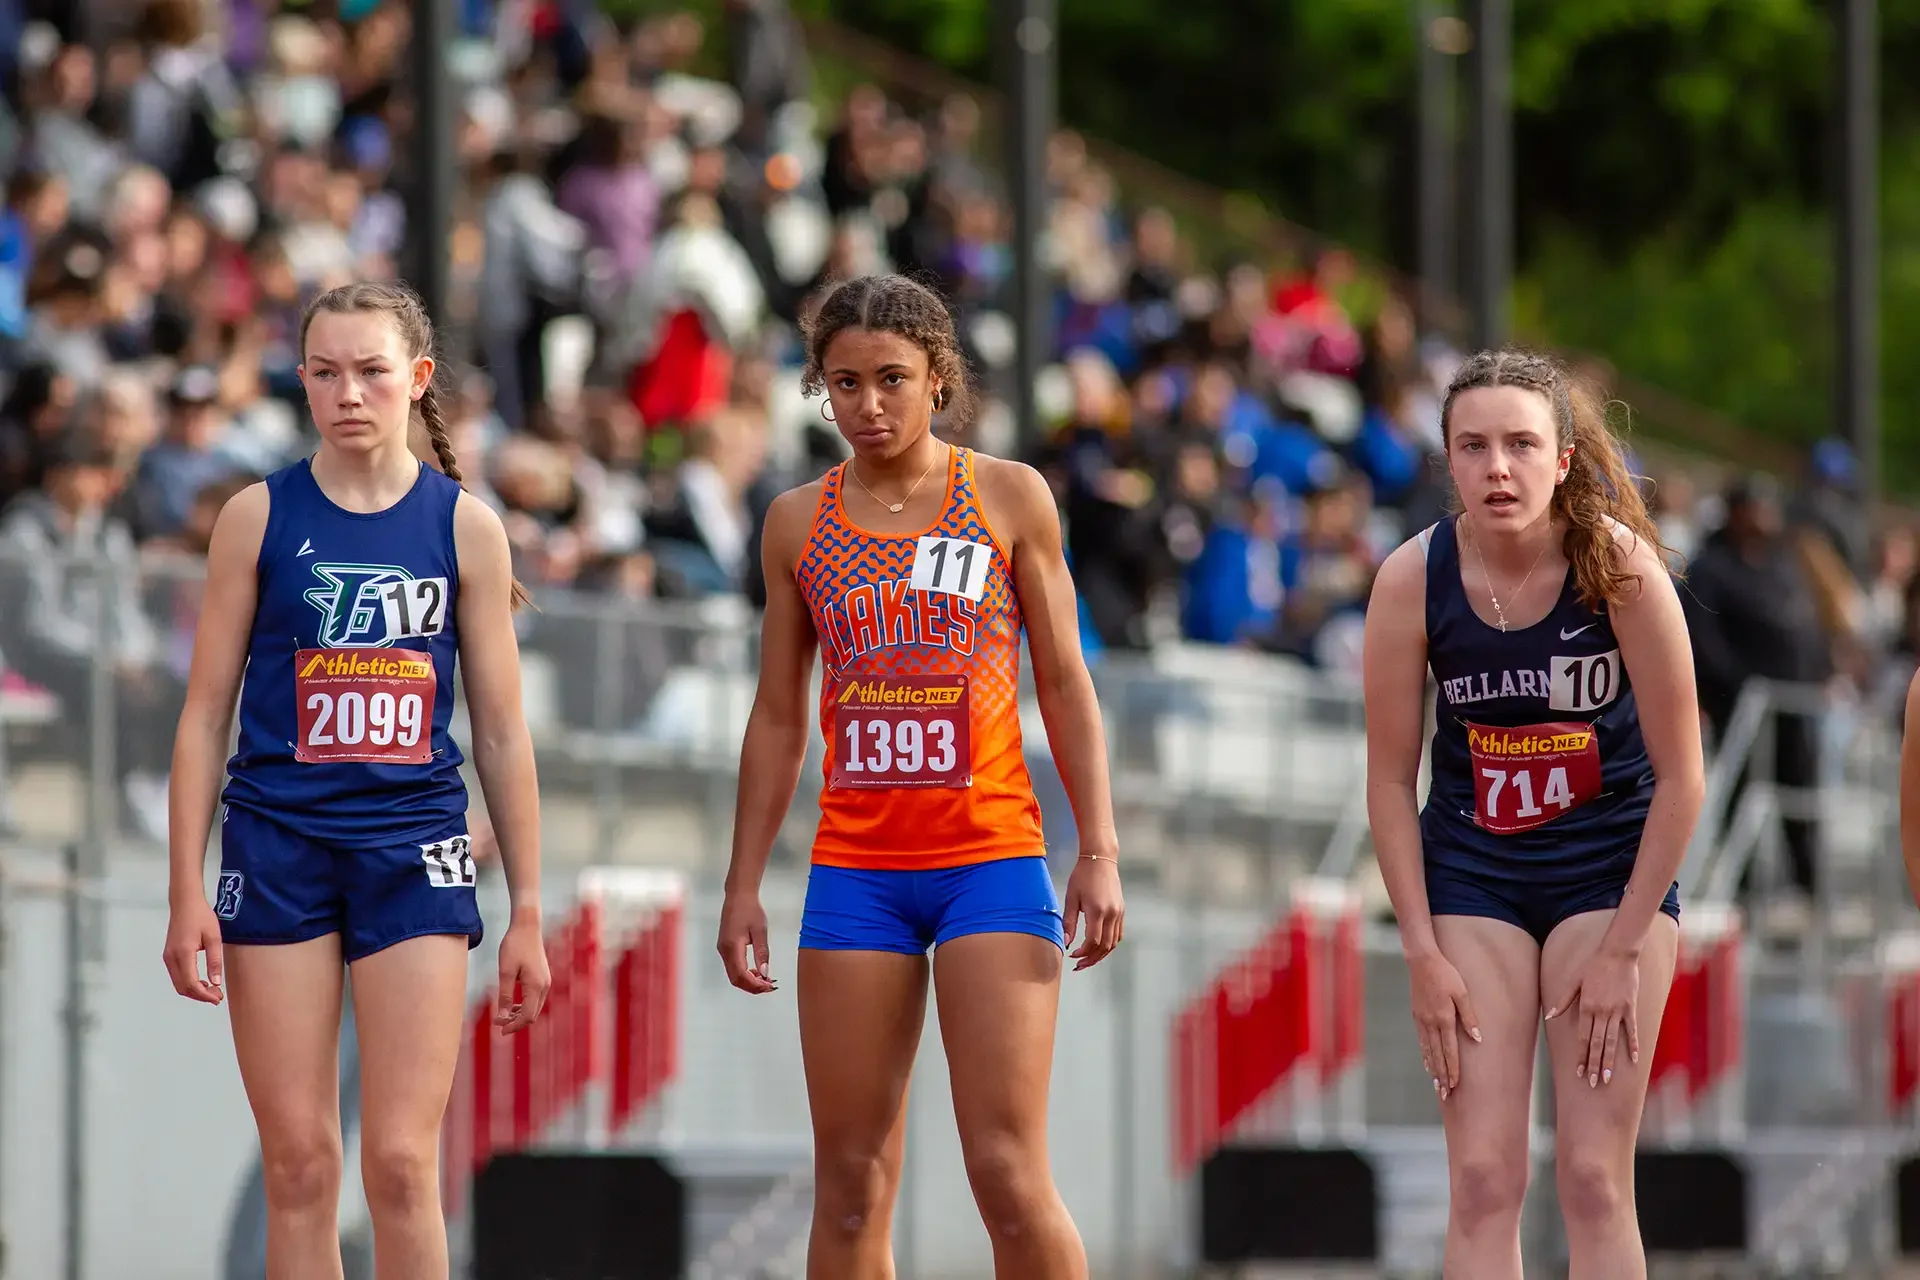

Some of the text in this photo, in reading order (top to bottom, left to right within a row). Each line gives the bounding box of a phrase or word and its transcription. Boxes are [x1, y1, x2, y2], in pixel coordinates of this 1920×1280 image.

[929, 540, 975, 593] 11
[387, 580, 441, 635] 12
[824, 578, 977, 670] LAKES
[1563, 656, 1611, 708] 10
[306, 691, 423, 747] 2099
[845, 719, 957, 773] 1393
[1482, 766, 1575, 818] 714
[426, 838, 473, 884] 12
